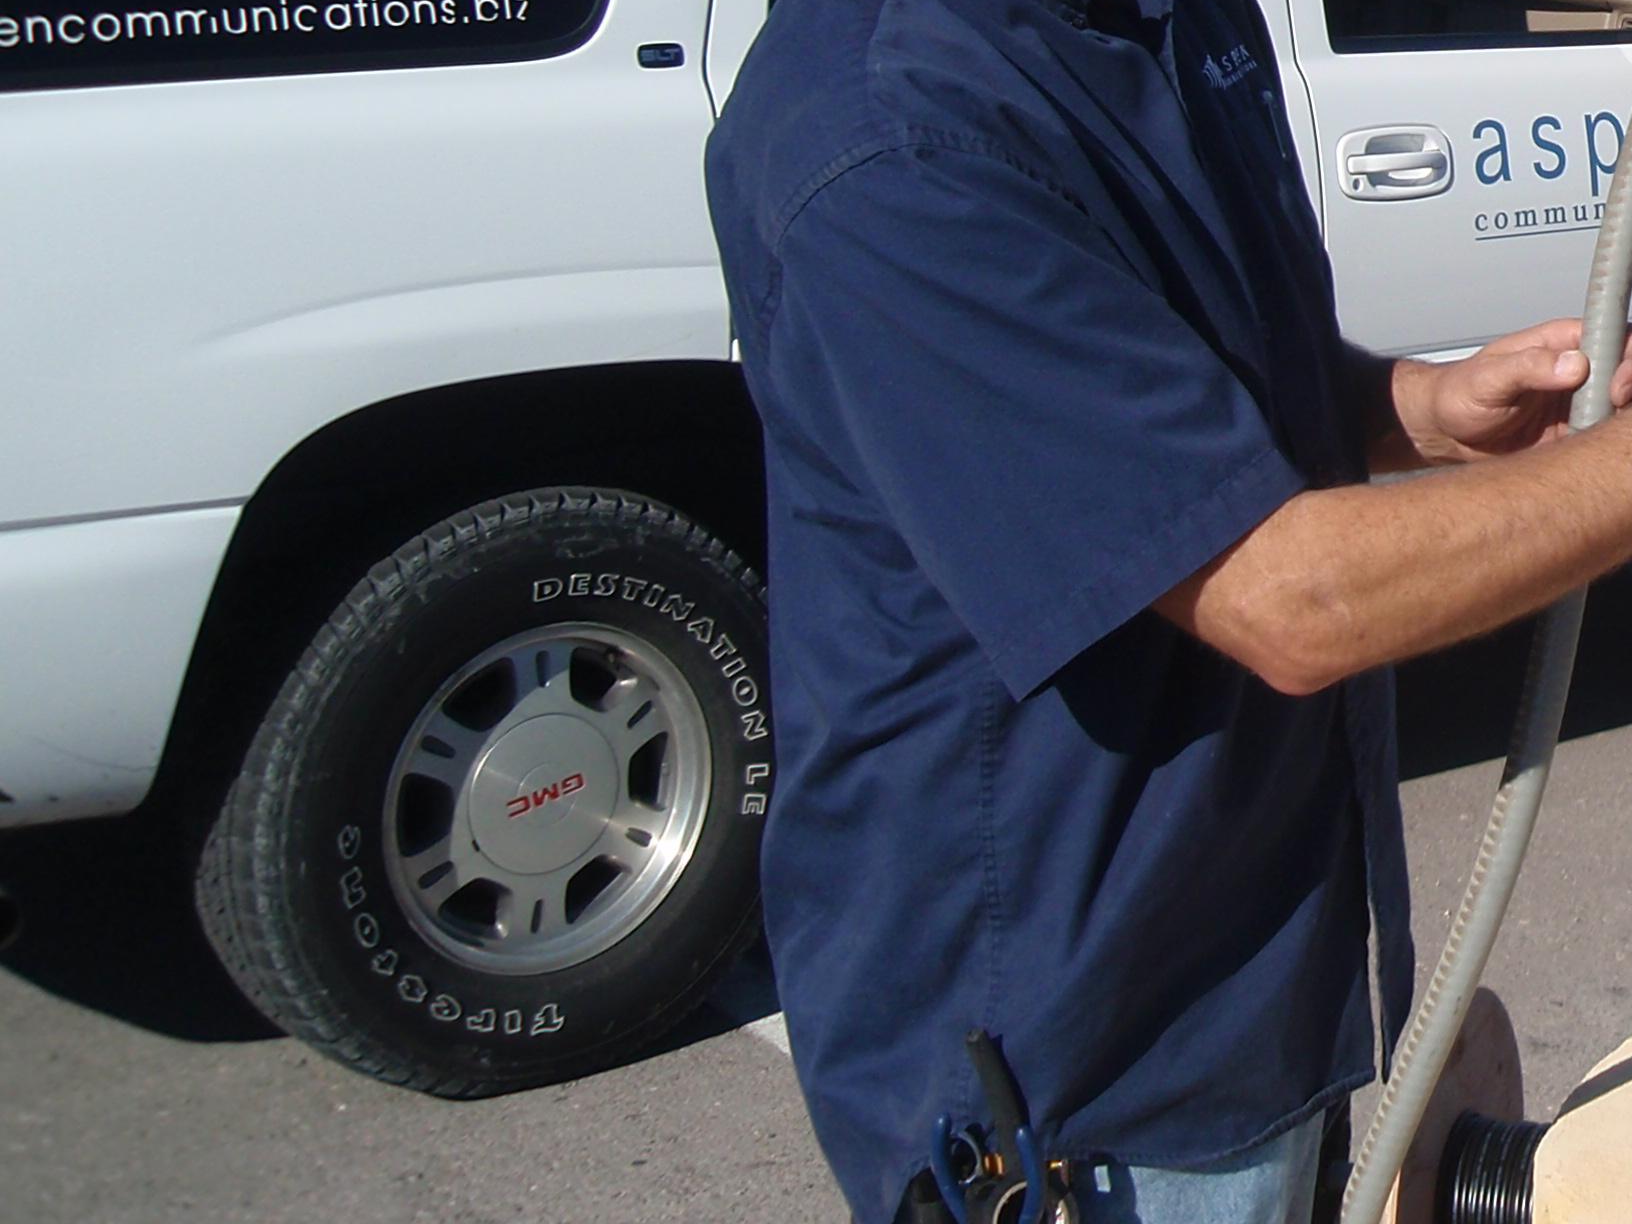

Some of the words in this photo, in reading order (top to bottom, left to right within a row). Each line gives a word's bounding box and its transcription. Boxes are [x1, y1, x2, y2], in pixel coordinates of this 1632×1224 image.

[532, 573, 769, 741] DESTINATION
[741, 762, 771, 816] LE
[506, 772, 584, 818] GMC
